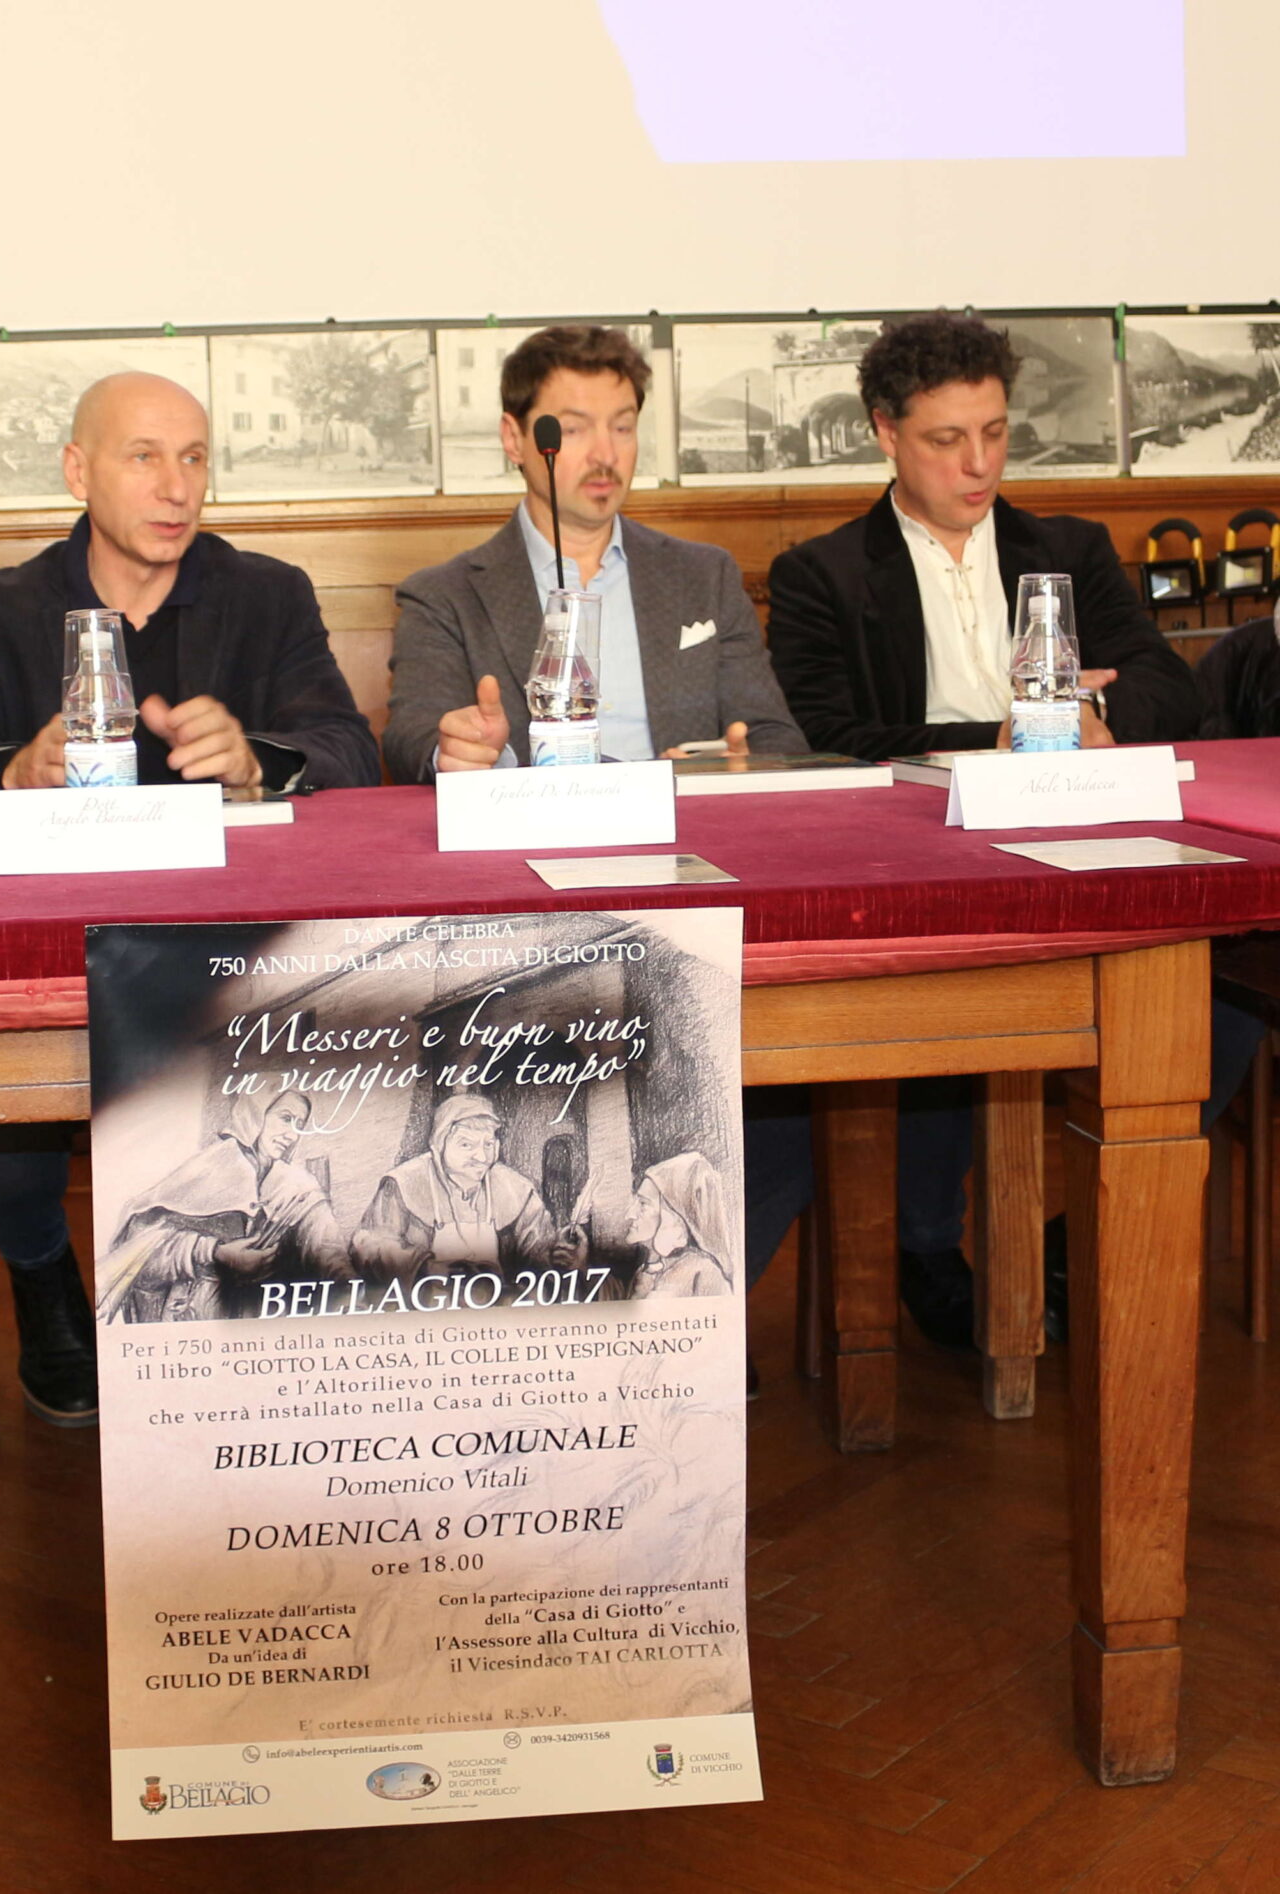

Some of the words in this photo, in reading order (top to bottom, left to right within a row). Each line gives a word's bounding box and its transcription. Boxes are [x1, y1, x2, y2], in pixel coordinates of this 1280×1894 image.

[1018, 772, 1060, 797] Abele
[1066, 769, 1117, 792] Vadacca
[344, 926, 419, 945] DANTE
[422, 923, 515, 941] CELEBRA
[209, 957, 246, 976] 750
[252, 954, 318, 975] ANNI
[324, 953, 408, 973] DALLA
[411, 947, 518, 969] NASCITA
[523, 947, 549, 966] DI
[553, 942, 645, 964] GIOTTO
[422, 1029, 445, 1048] e
[460, 987, 554, 1048] buon
[566, 1008, 650, 1041] vino
[221, 1061, 266, 1096] in
[278, 1055, 426, 1135] viaggio
[436, 1034, 504, 1088] nel
[259, 1274, 502, 1319] BELLAGIO
[512, 1268, 611, 1308] 2017
[122, 1342, 155, 1358] Per
[164, 1342, 169, 1356] i
[178, 1339, 212, 1355] 750
[221, 1338, 265, 1353] anni
[274, 1334, 325, 1350] dalla
[334, 1331, 406, 1348] nascita
[415, 1329, 434, 1344] di
[442, 1327, 507, 1342] Giotto
[516, 1323, 608, 1338] verranno
[616, 1315, 718, 1338] presentati
[136, 1365, 150, 1380] il
[161, 1364, 212, 1378] libro
[322, 1356, 350, 1372] LA
[356, 1353, 419, 1370] CASA,
[426, 1351, 444, 1366] IL
[451, 1347, 519, 1364] COLLE
[526, 1346, 548, 1361] DI
[278, 1384, 288, 1396] e
[442, 1373, 462, 1388] in
[472, 1370, 576, 1386] terracotta
[149, 1410, 184, 1425] che
[196, 1405, 250, 1422] verrà
[260, 1403, 362, 1420] installato
[372, 1398, 424, 1414] nella
[434, 1395, 482, 1411] Casa
[492, 1393, 512, 1407] di
[521, 1390, 588, 1406] Giotto
[598, 1392, 608, 1402] a
[618, 1384, 694, 1400] Vicchio
[214, 1436, 421, 1470] BIBLIOTECA
[431, 1424, 638, 1459] COMUNALE
[326, 1472, 454, 1498] Domenico
[464, 1466, 528, 1490] Vitali
[227, 1518, 422, 1551] DOMENICA
[435, 1517, 451, 1540] 8
[464, 1506, 625, 1539] OTTOBRE
[371, 1560, 411, 1577] ore
[421, 1553, 484, 1574] 18.00
[439, 1594, 468, 1606] Con
[473, 1593, 485, 1605] la
[490, 1586, 595, 1607] partecipazione
[599, 1585, 621, 1598] dei
[626, 1578, 729, 1597] rappresentanti
[155, 1611, 200, 1627] Opere
[204, 1609, 275, 1622] realizzate
[485, 1613, 520, 1626] della
[582, 1607, 600, 1620] di
[678, 1605, 686, 1614] e
[162, 1629, 231, 1647] ABELE
[238, 1624, 351, 1644] VADACCA
[537, 1631, 567, 1645] alla
[573, 1627, 638, 1643] Cultura
[648, 1624, 665, 1637] di
[671, 1620, 740, 1636] Vicchio,
[208, 1652, 228, 1664] Da
[293, 1648, 306, 1659] di
[450, 1659, 463, 1673] il
[469, 1654, 572, 1671] Vicesindaco
[576, 1651, 611, 1665] TAI
[617, 1644, 723, 1663] CARLOTTA
[145, 1673, 221, 1690] GIULIO
[228, 1672, 255, 1686] DE
[263, 1665, 370, 1684] BERNARDI
[319, 1716, 420, 1730] cortesemente
[426, 1711, 493, 1725] richiesta
[504, 1706, 568, 1720] R.S.V.P.
[530, 1732, 610, 1745] 0039-3420931568
[447, 1757, 507, 1768] ASSOCIAZIONE
[690, 1752, 730, 1762] COMUNE
[691, 1765, 701, 1774] DI
[704, 1763, 743, 1773] VICCHIO
[459, 1779, 490, 1787] GIOTTO
[492, 1778, 497, 1786] E
[479, 1768, 502, 1776] TERRE
[170, 1783, 270, 1810] BELLAGIO
